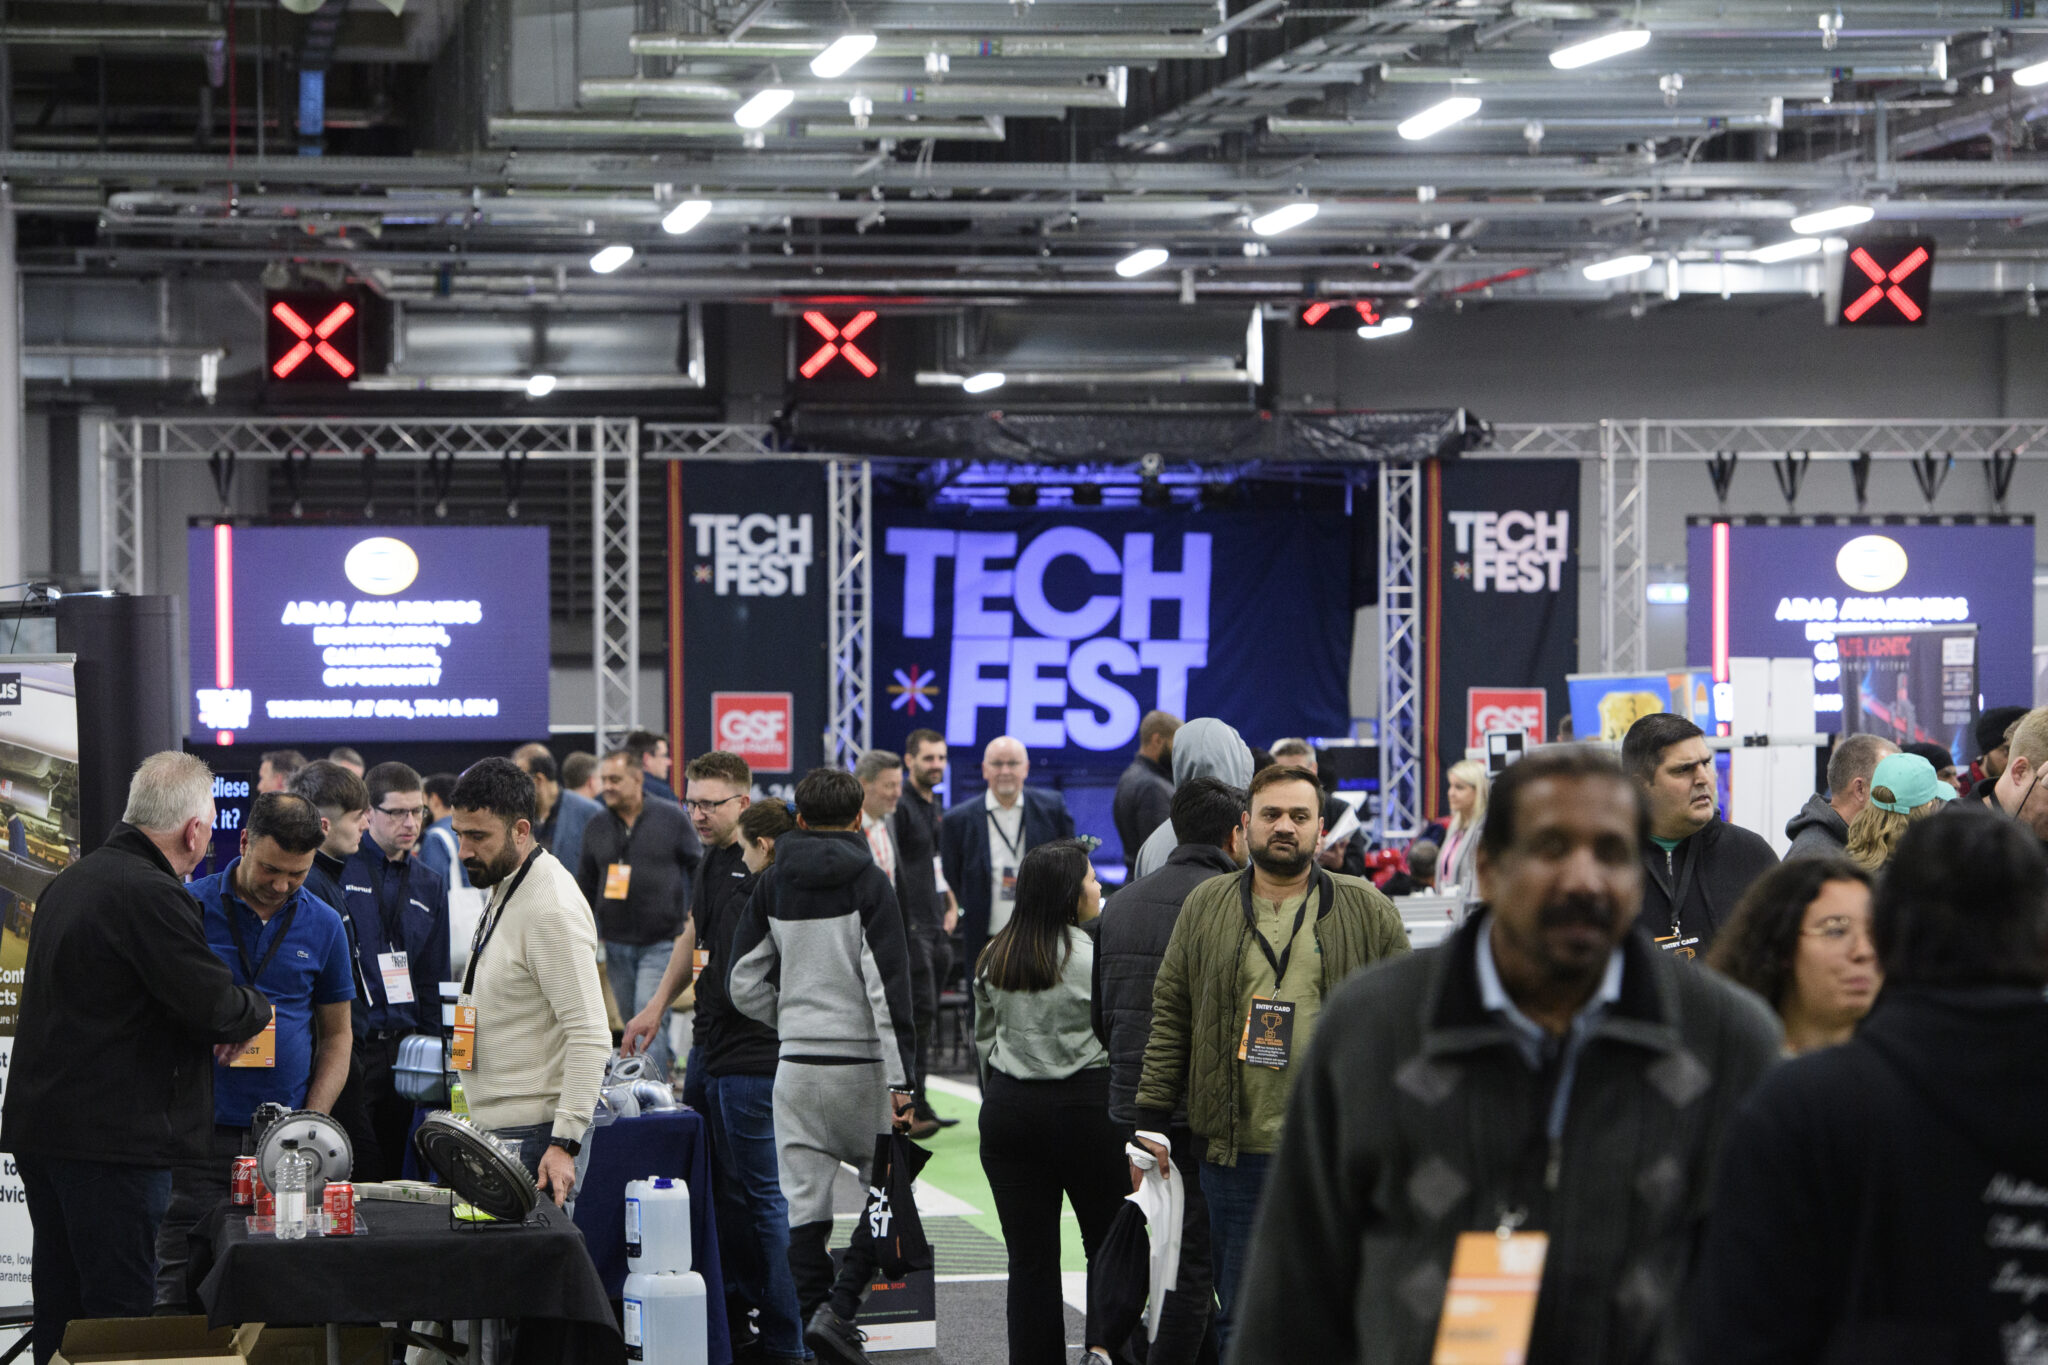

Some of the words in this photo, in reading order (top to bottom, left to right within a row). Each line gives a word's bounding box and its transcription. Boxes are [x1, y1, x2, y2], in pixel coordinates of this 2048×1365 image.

[689, 513, 813, 556] TECH
[1448, 510, 1569, 553] TECH
[714, 553, 813, 596] FEST
[886, 526, 1212, 641] TECH
[1473, 550, 1567, 592] FEST
[945, 637, 1207, 751] FEST
[720, 710, 785, 741] GSF
[1476, 706, 1539, 735] GSF
[211, 776, 249, 797] diese
[221, 808, 240, 829] it?
[0, 967, 25, 984] ont
[1256, 1003, 1273, 1011] ENTRY
[4, 1160, 18, 1176] to
